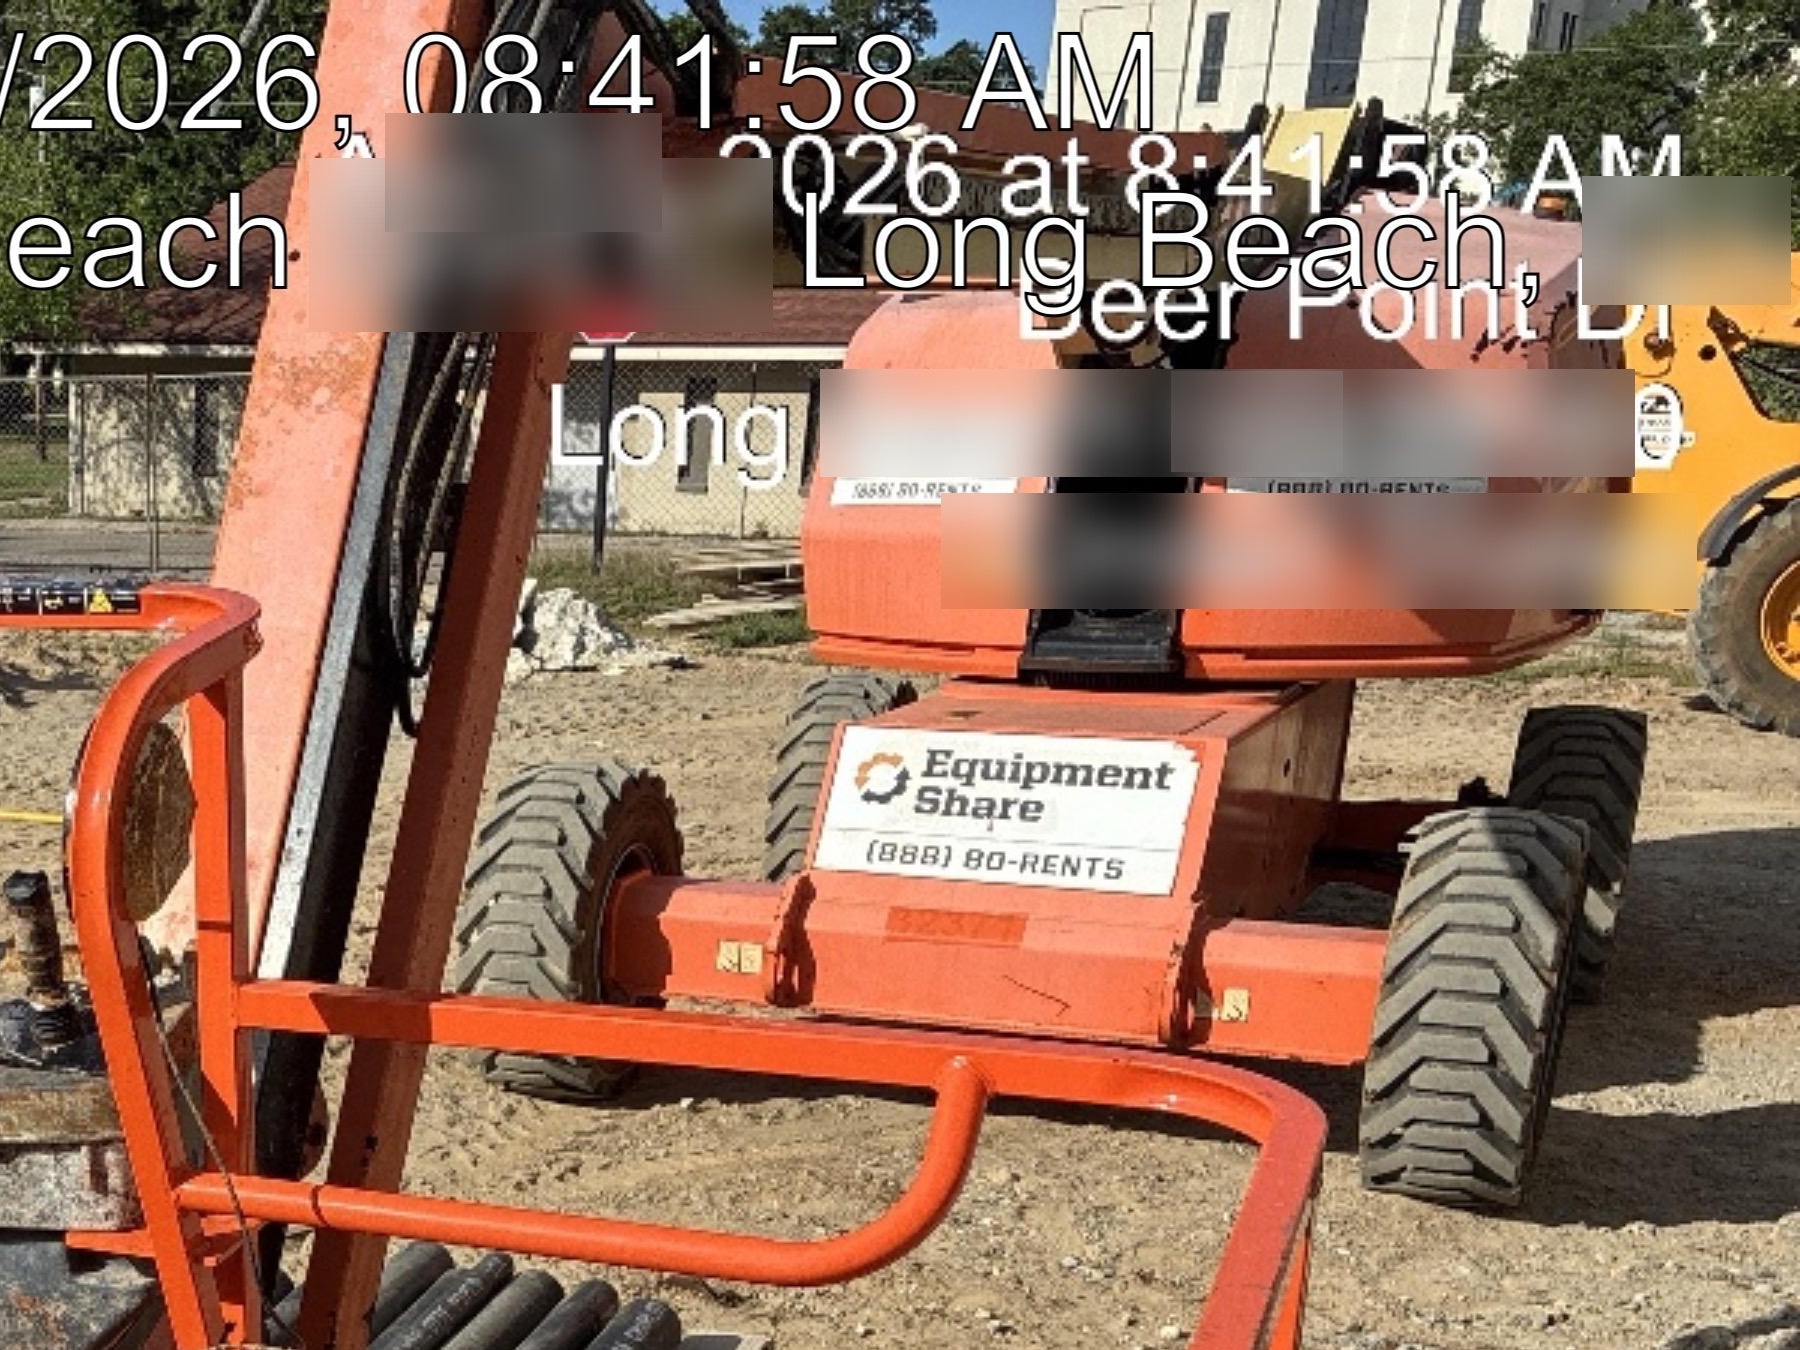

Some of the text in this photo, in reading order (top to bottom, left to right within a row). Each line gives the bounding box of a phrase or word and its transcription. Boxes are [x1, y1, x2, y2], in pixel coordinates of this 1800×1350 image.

[920, 748, 1176, 793] Equipment
[913, 785, 1046, 823] Share
[865, 839, 1125, 882] (888) 80-RENTS
